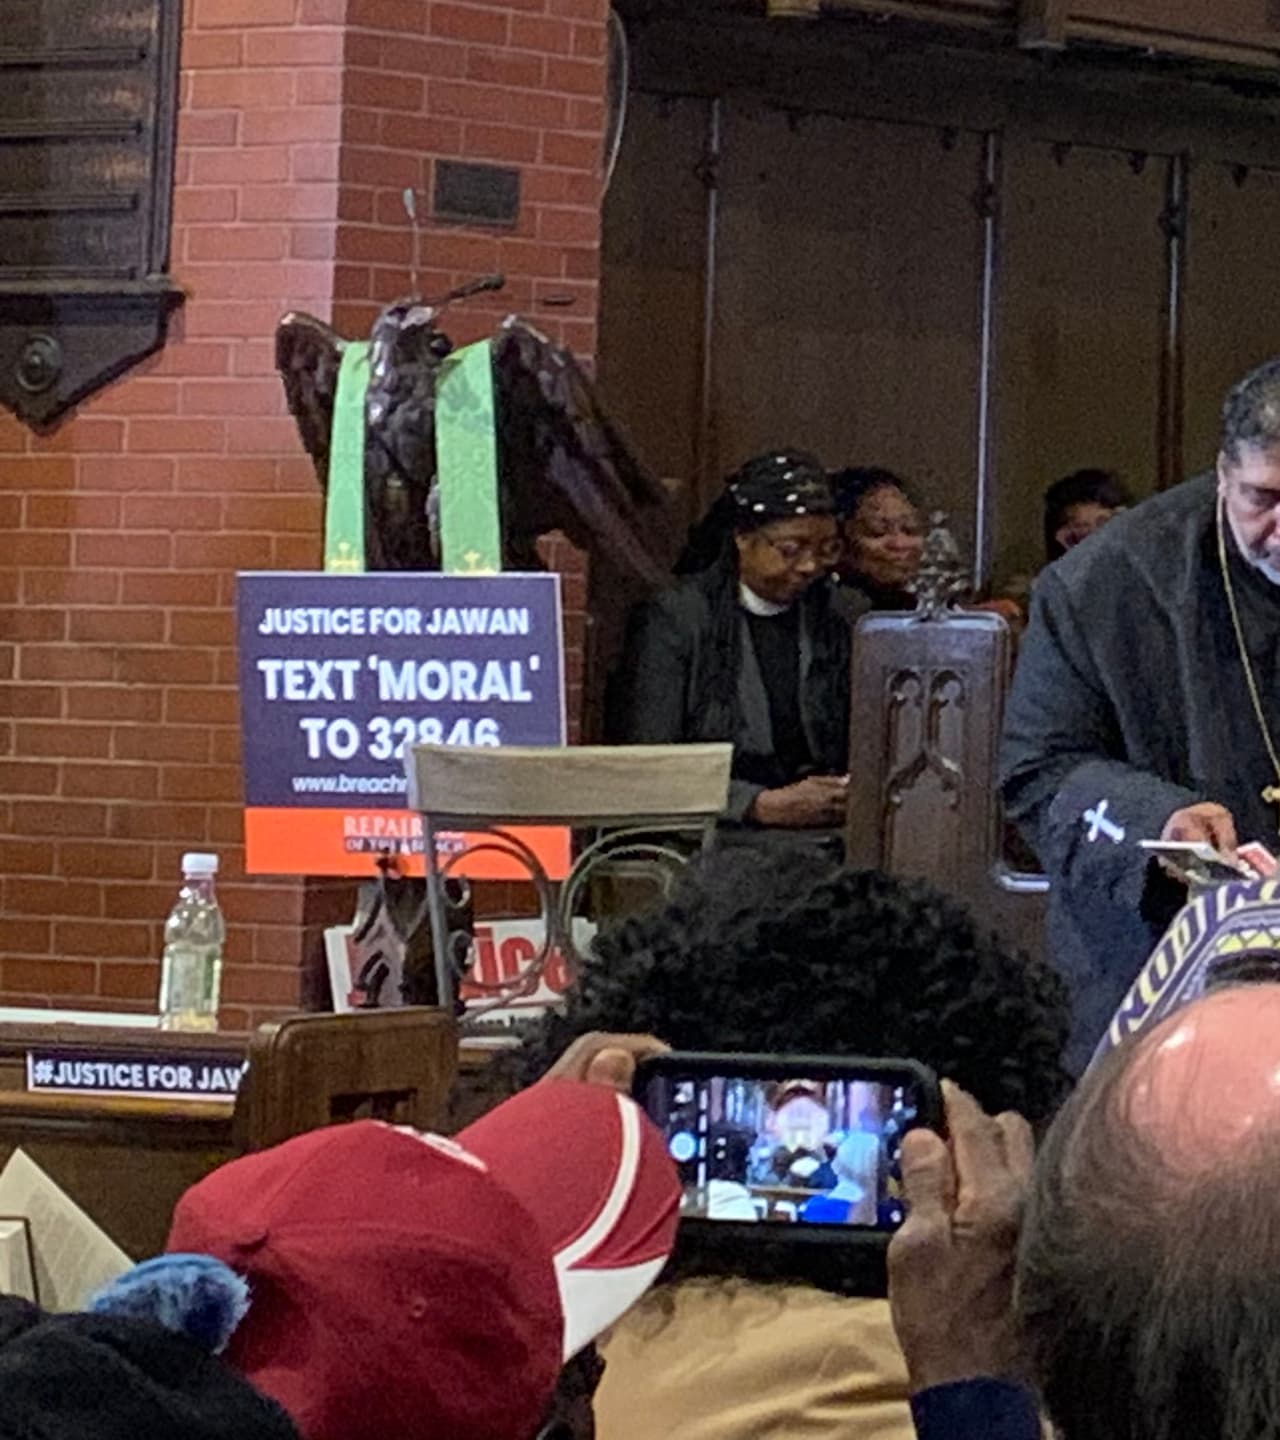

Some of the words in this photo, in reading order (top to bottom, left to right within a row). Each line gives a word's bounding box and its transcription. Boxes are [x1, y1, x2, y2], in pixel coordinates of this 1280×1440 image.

[258, 607, 365, 634] JUSTICE
[369, 608, 421, 634] FOR
[426, 608, 529, 634] JAWAN
[256, 660, 361, 700] TEXT
[367, 654, 540, 701] 'MORAL'
[299, 717, 360, 759] TO
[367, 716, 500, 760] 32846
[343, 816, 464, 838] REPAIR
[34, 1060, 145, 1088] #JUSTICE
[147, 1064, 193, 1089] FOR
